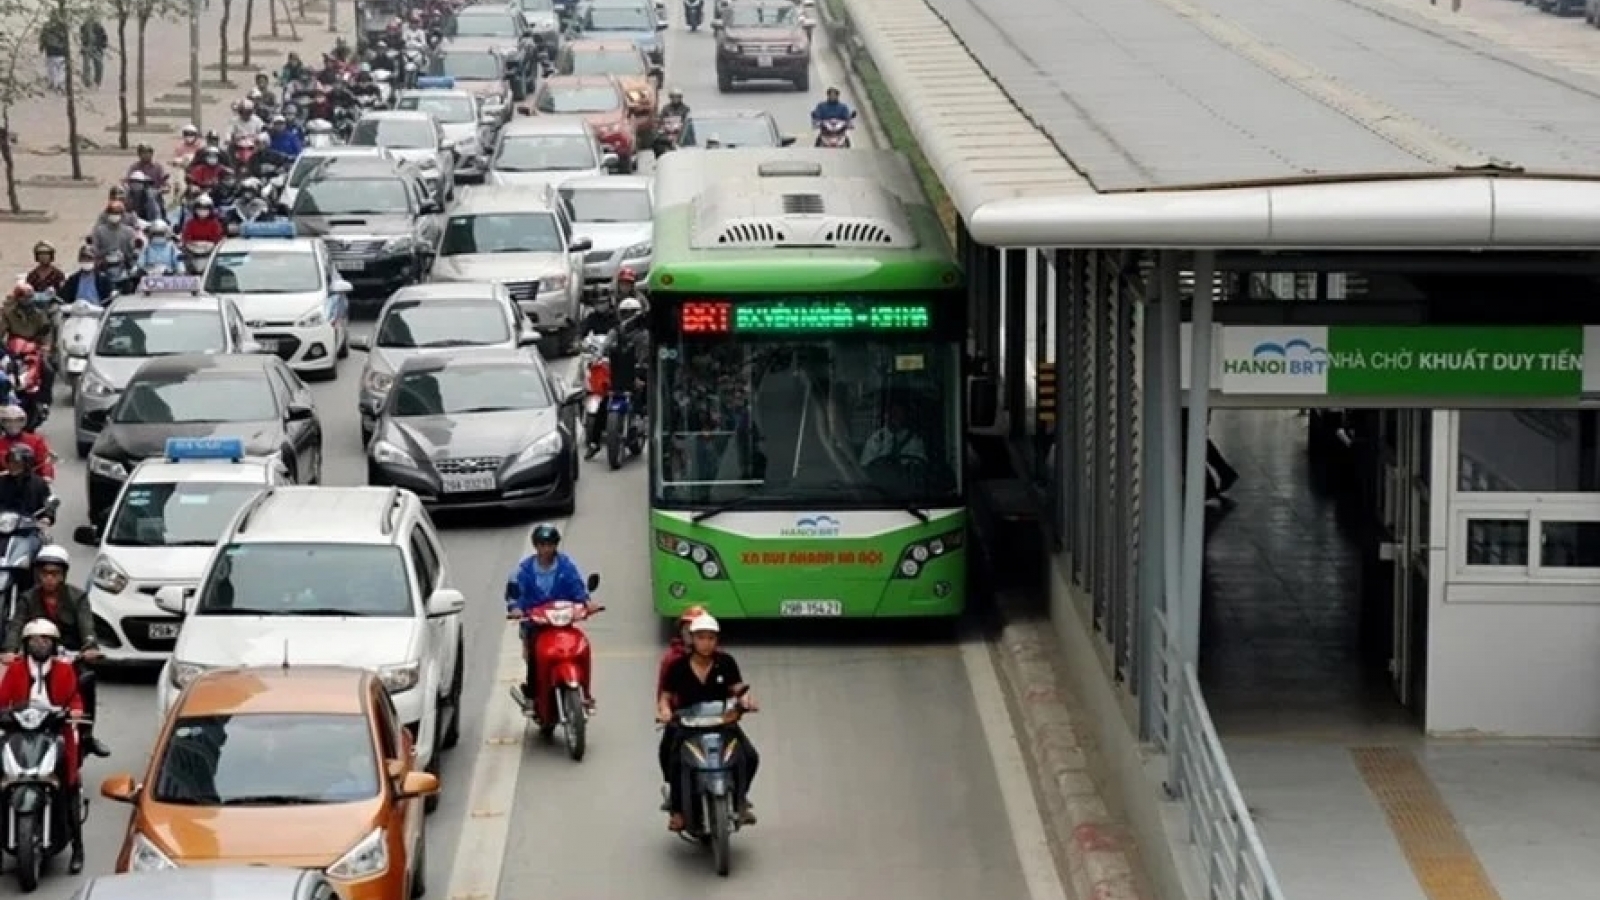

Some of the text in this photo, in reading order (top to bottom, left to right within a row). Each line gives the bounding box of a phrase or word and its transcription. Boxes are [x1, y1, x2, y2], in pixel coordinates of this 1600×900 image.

[682, 302, 731, 332] BRT
[1223, 360, 1327, 375] HANOI BRT
[1327, 347, 1583, 371] NHÀ CHỜ KHUẤT DUY TIẾN
[781, 527, 839, 537] HANOI BRT
